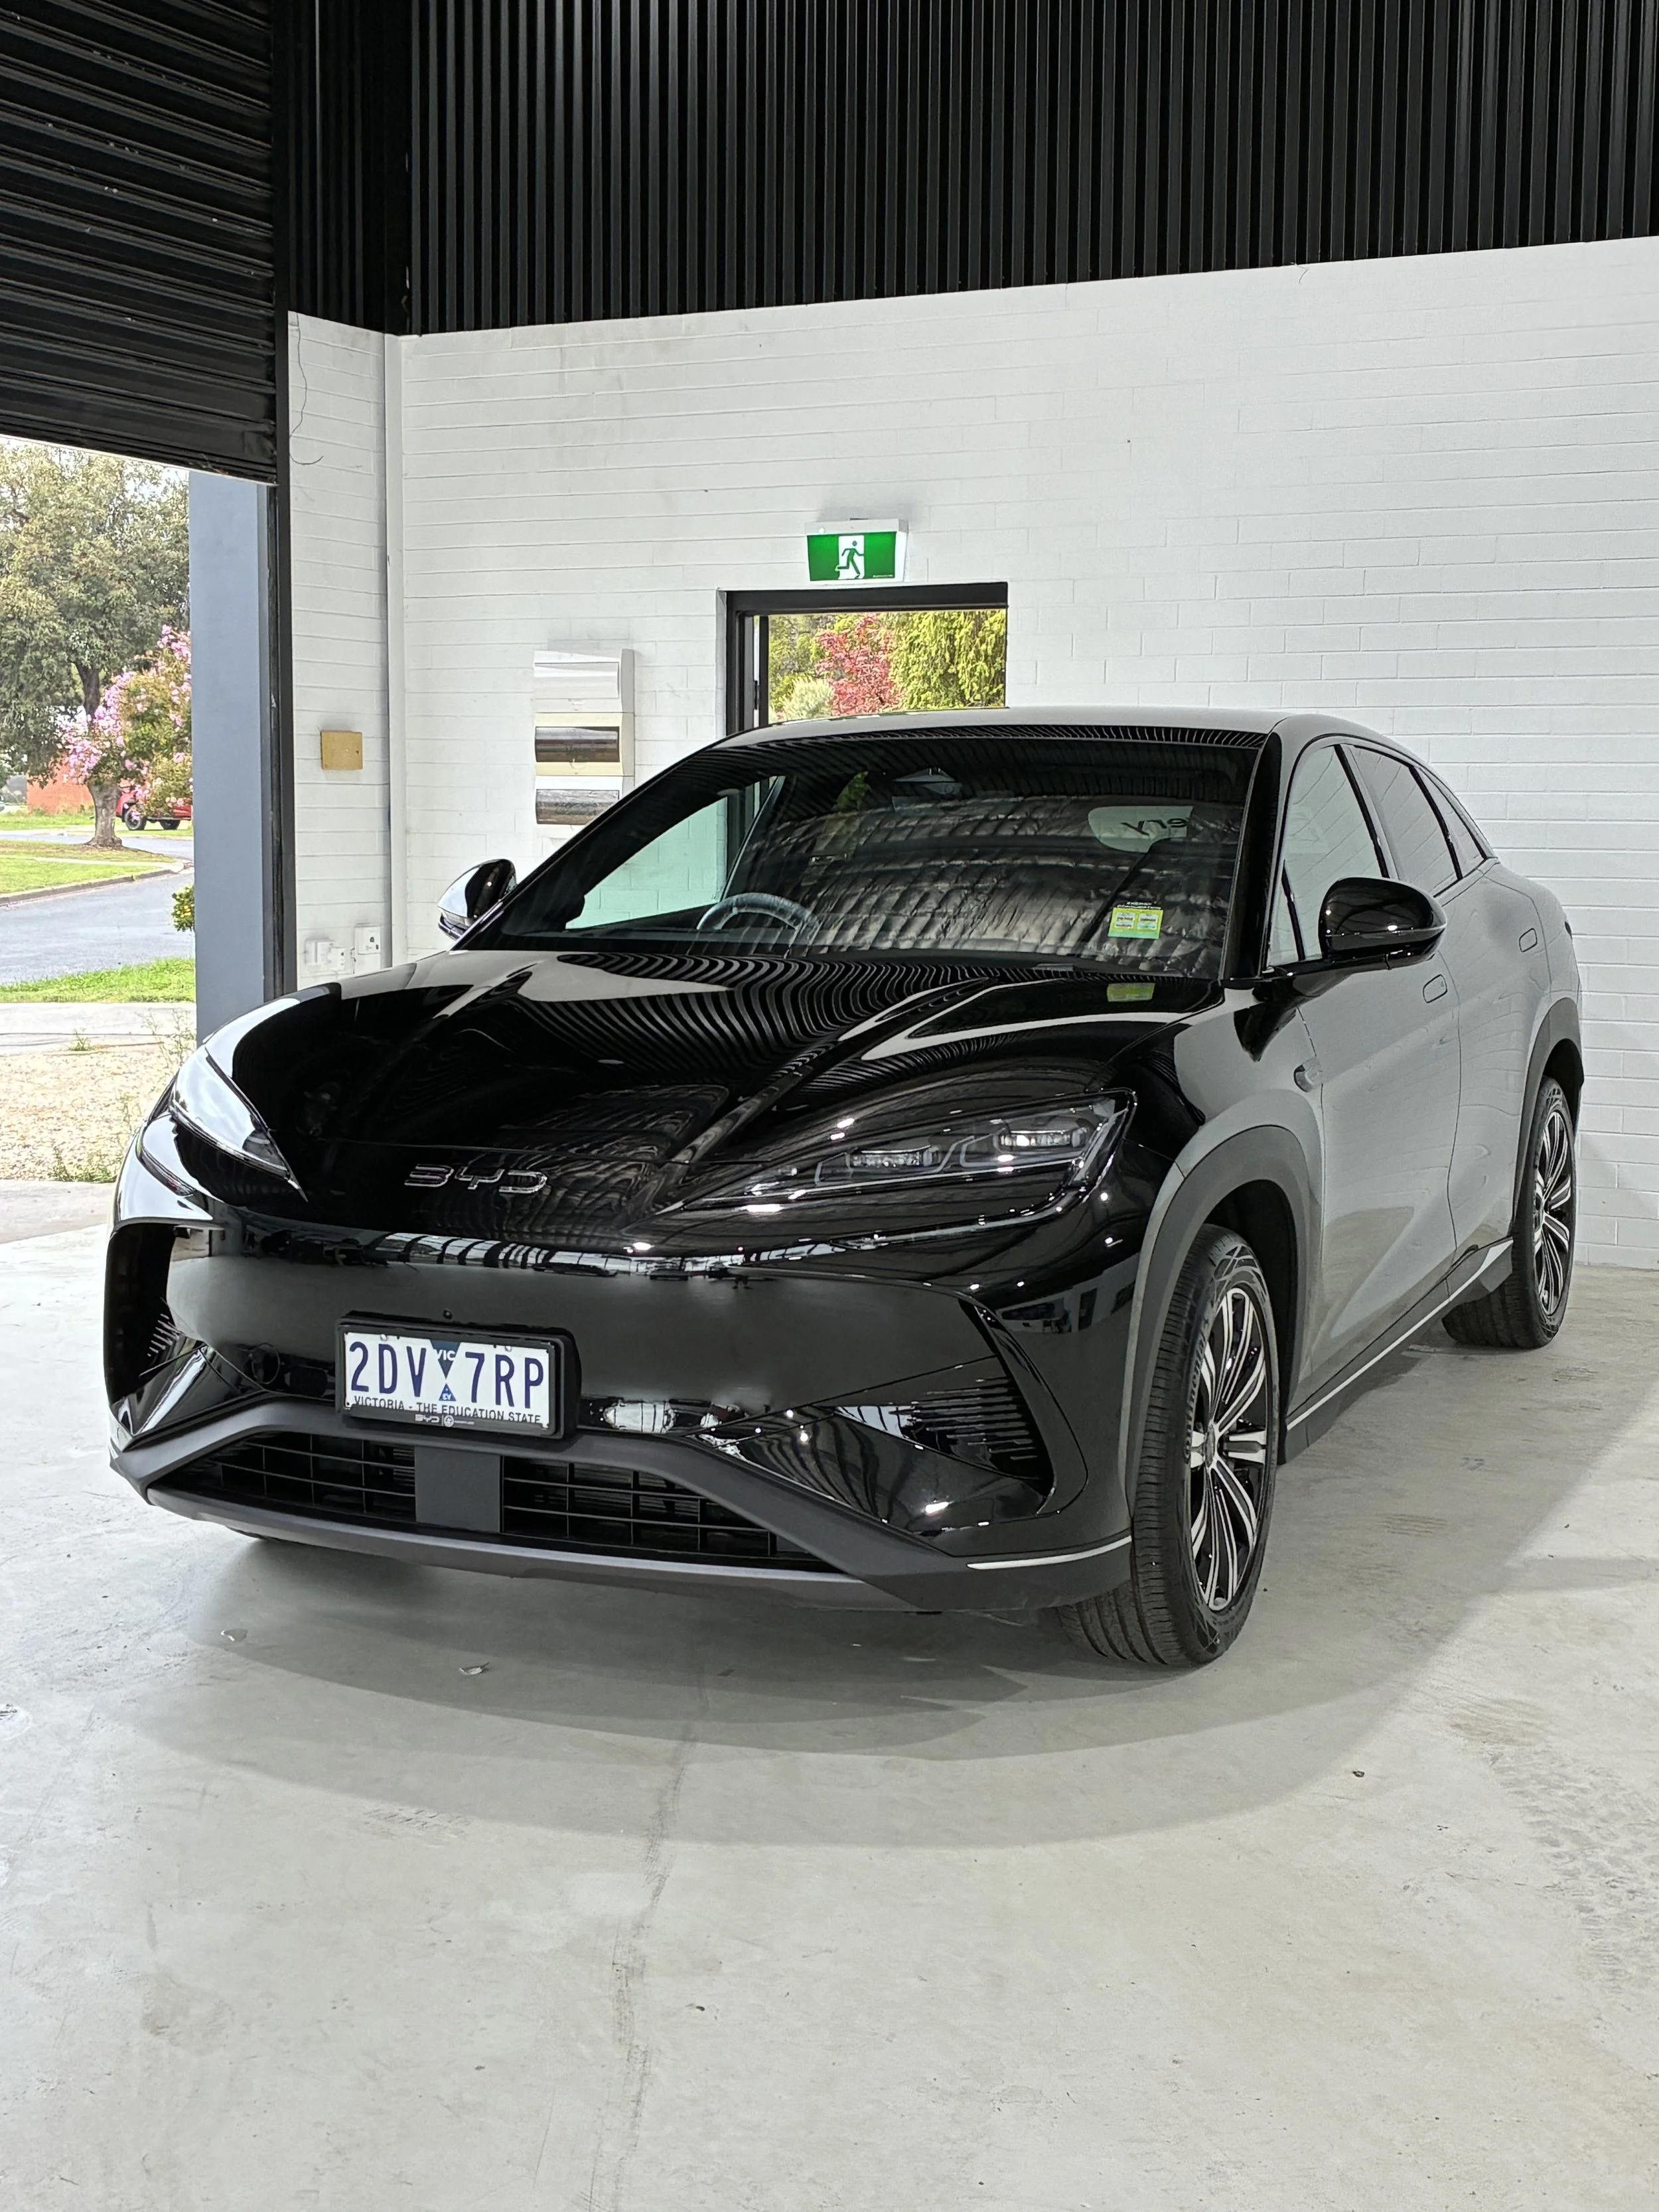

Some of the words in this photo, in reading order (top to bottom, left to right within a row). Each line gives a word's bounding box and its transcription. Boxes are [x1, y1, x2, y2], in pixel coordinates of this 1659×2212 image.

[404, 1163, 547, 1193] BYD
[435, 1349, 456, 1361] VIC
[349, 1341, 427, 1397] 2DV
[465, 1352, 543, 1409] 7RP
[354, 1395, 405, 1410] VICTORIA
[416, 1402, 438, 1414] THE
[442, 1404, 504, 1420] EDUCATION
[508, 1412, 541, 1424] STATE
